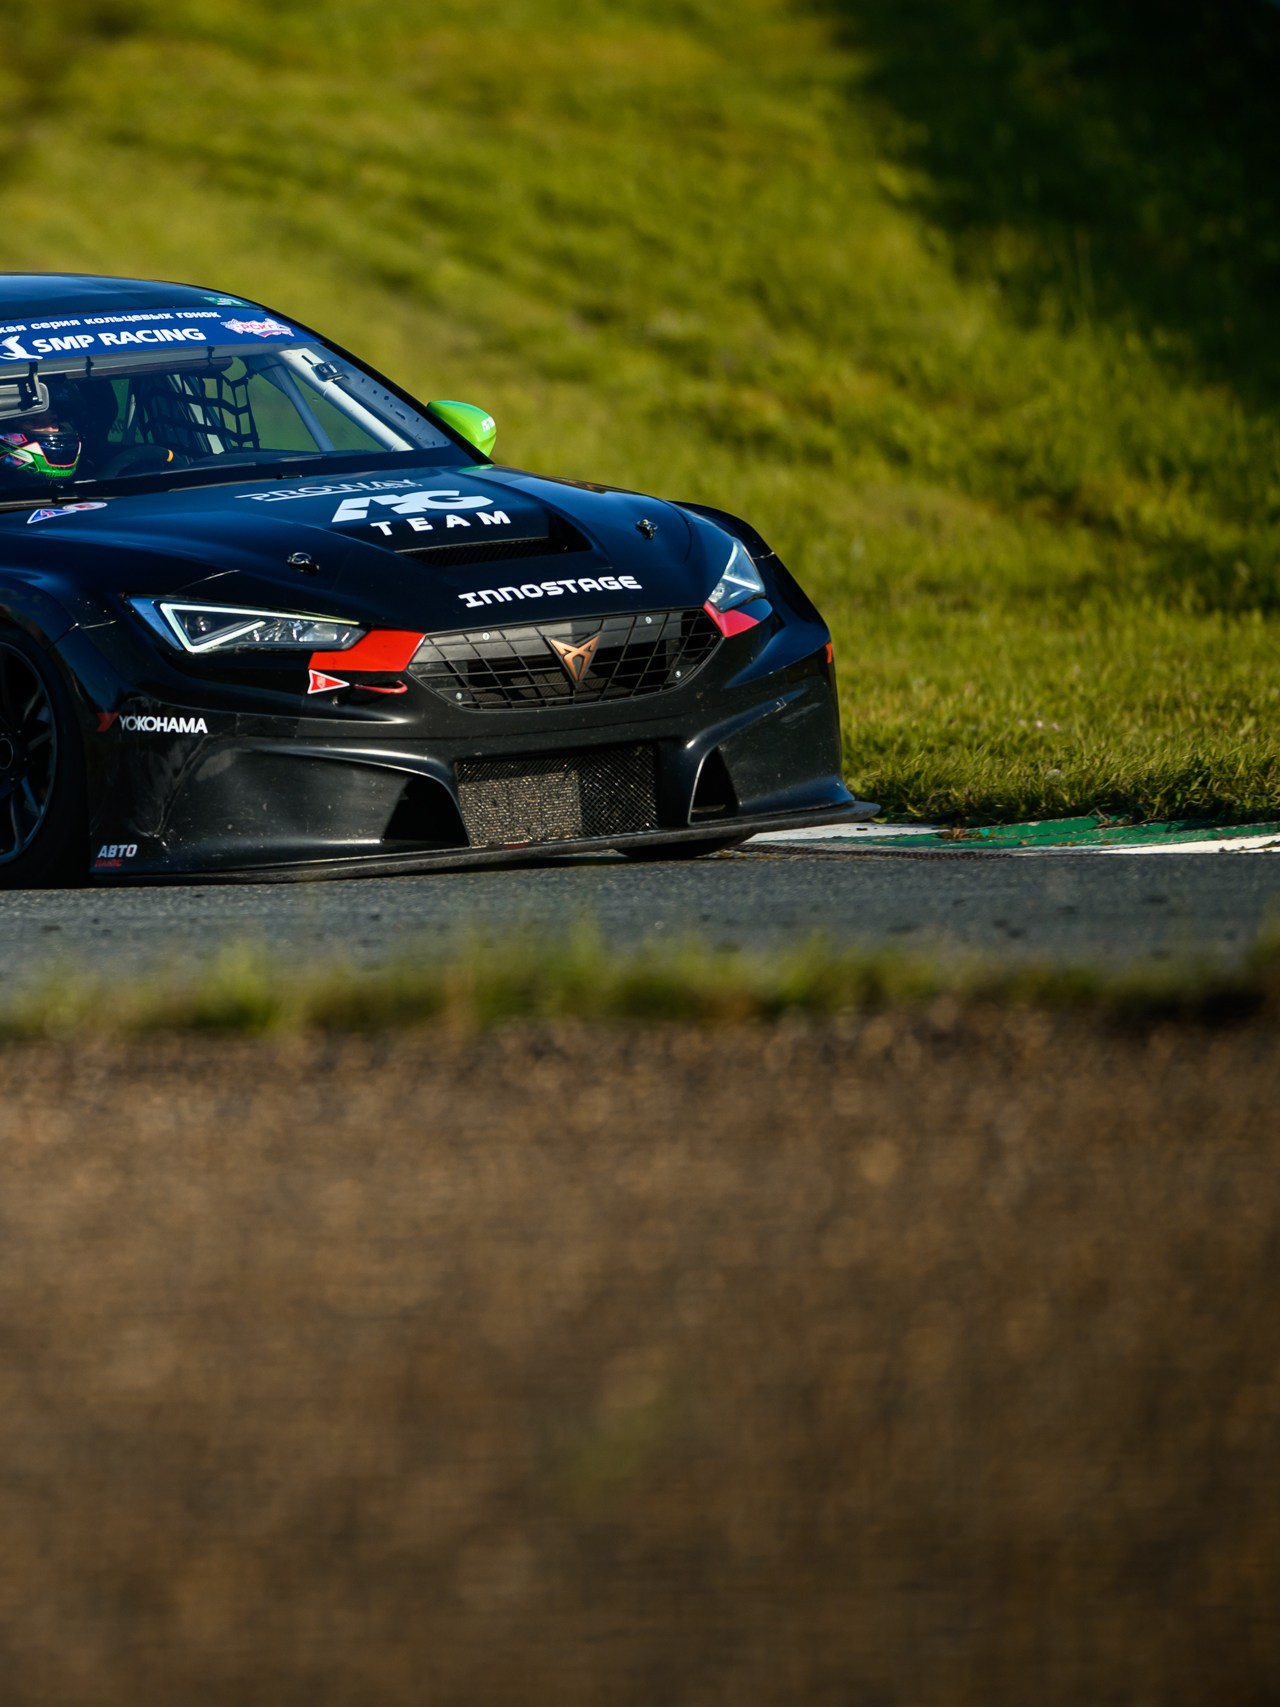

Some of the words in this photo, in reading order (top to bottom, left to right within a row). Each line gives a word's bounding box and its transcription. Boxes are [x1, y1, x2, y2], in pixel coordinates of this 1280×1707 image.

[30, 318, 81, 330] серия
[84, 312, 174, 326] кольцевых
[176, 311, 222, 319] гонок
[32, 334, 95, 353] SMP
[97, 327, 207, 346] RACING
[369, 510, 512, 537] TEAM
[458, 575, 643, 608] INNOSTAGE
[120, 714, 209, 734] YOKOHAMA
[97, 843, 139, 859] АВТО
